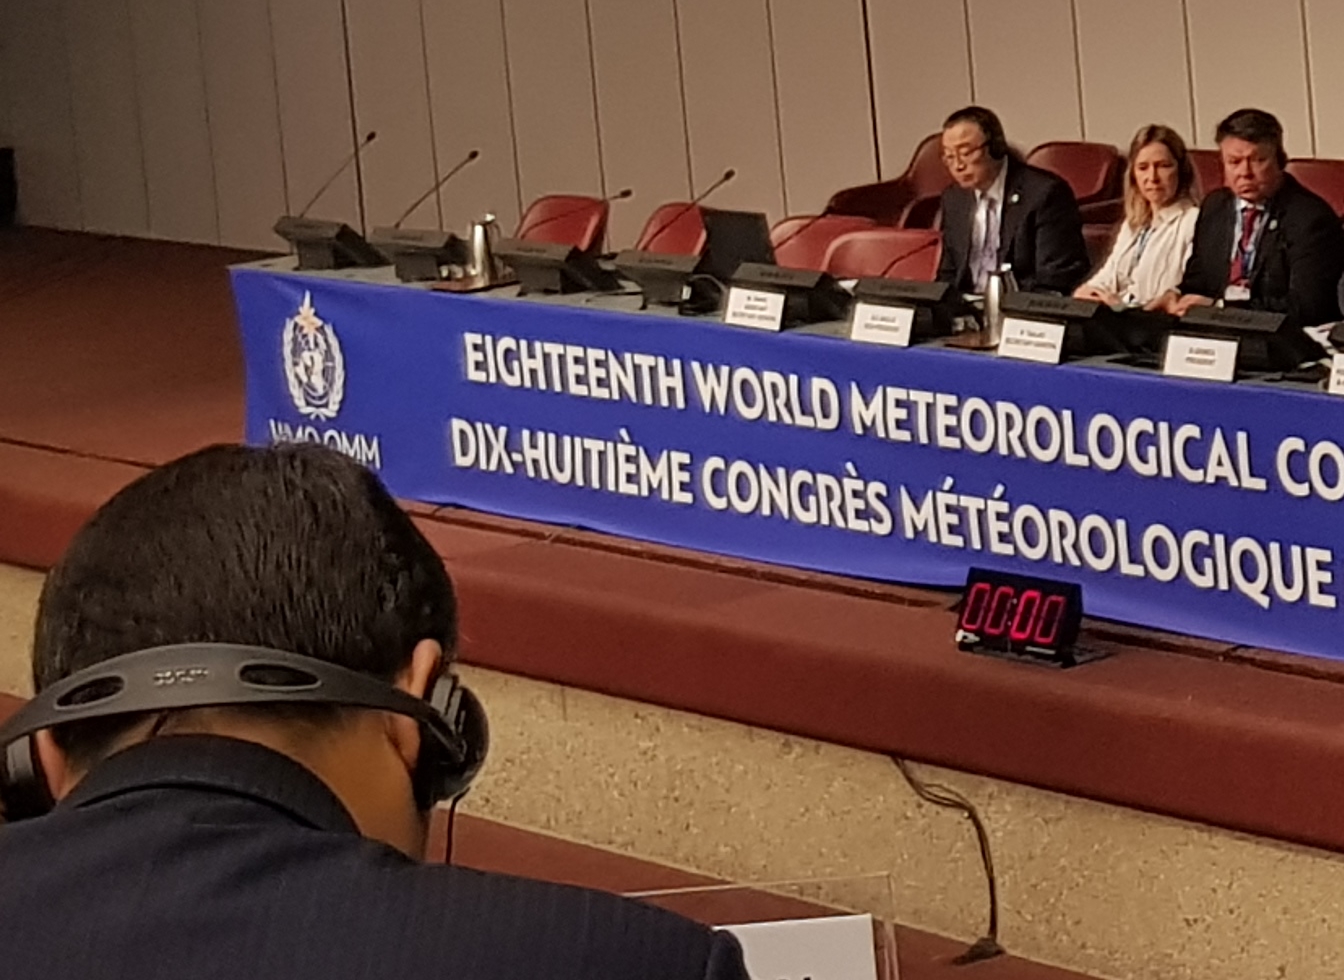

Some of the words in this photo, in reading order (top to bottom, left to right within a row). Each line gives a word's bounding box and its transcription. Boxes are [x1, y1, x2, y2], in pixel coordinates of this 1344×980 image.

[463, 330, 686, 411] EIGHTEENTH
[692, 359, 840, 431] WORLD
[850, 380, 1267, 492] METEOROLOGICAL
[450, 416, 693, 506] DIX-HUITIÈME
[702, 456, 893, 537] CONGRÈS
[900, 476, 1337, 610] MÉTÉOROLOGIQUE
[961, 582, 1066, 644] 00:00
